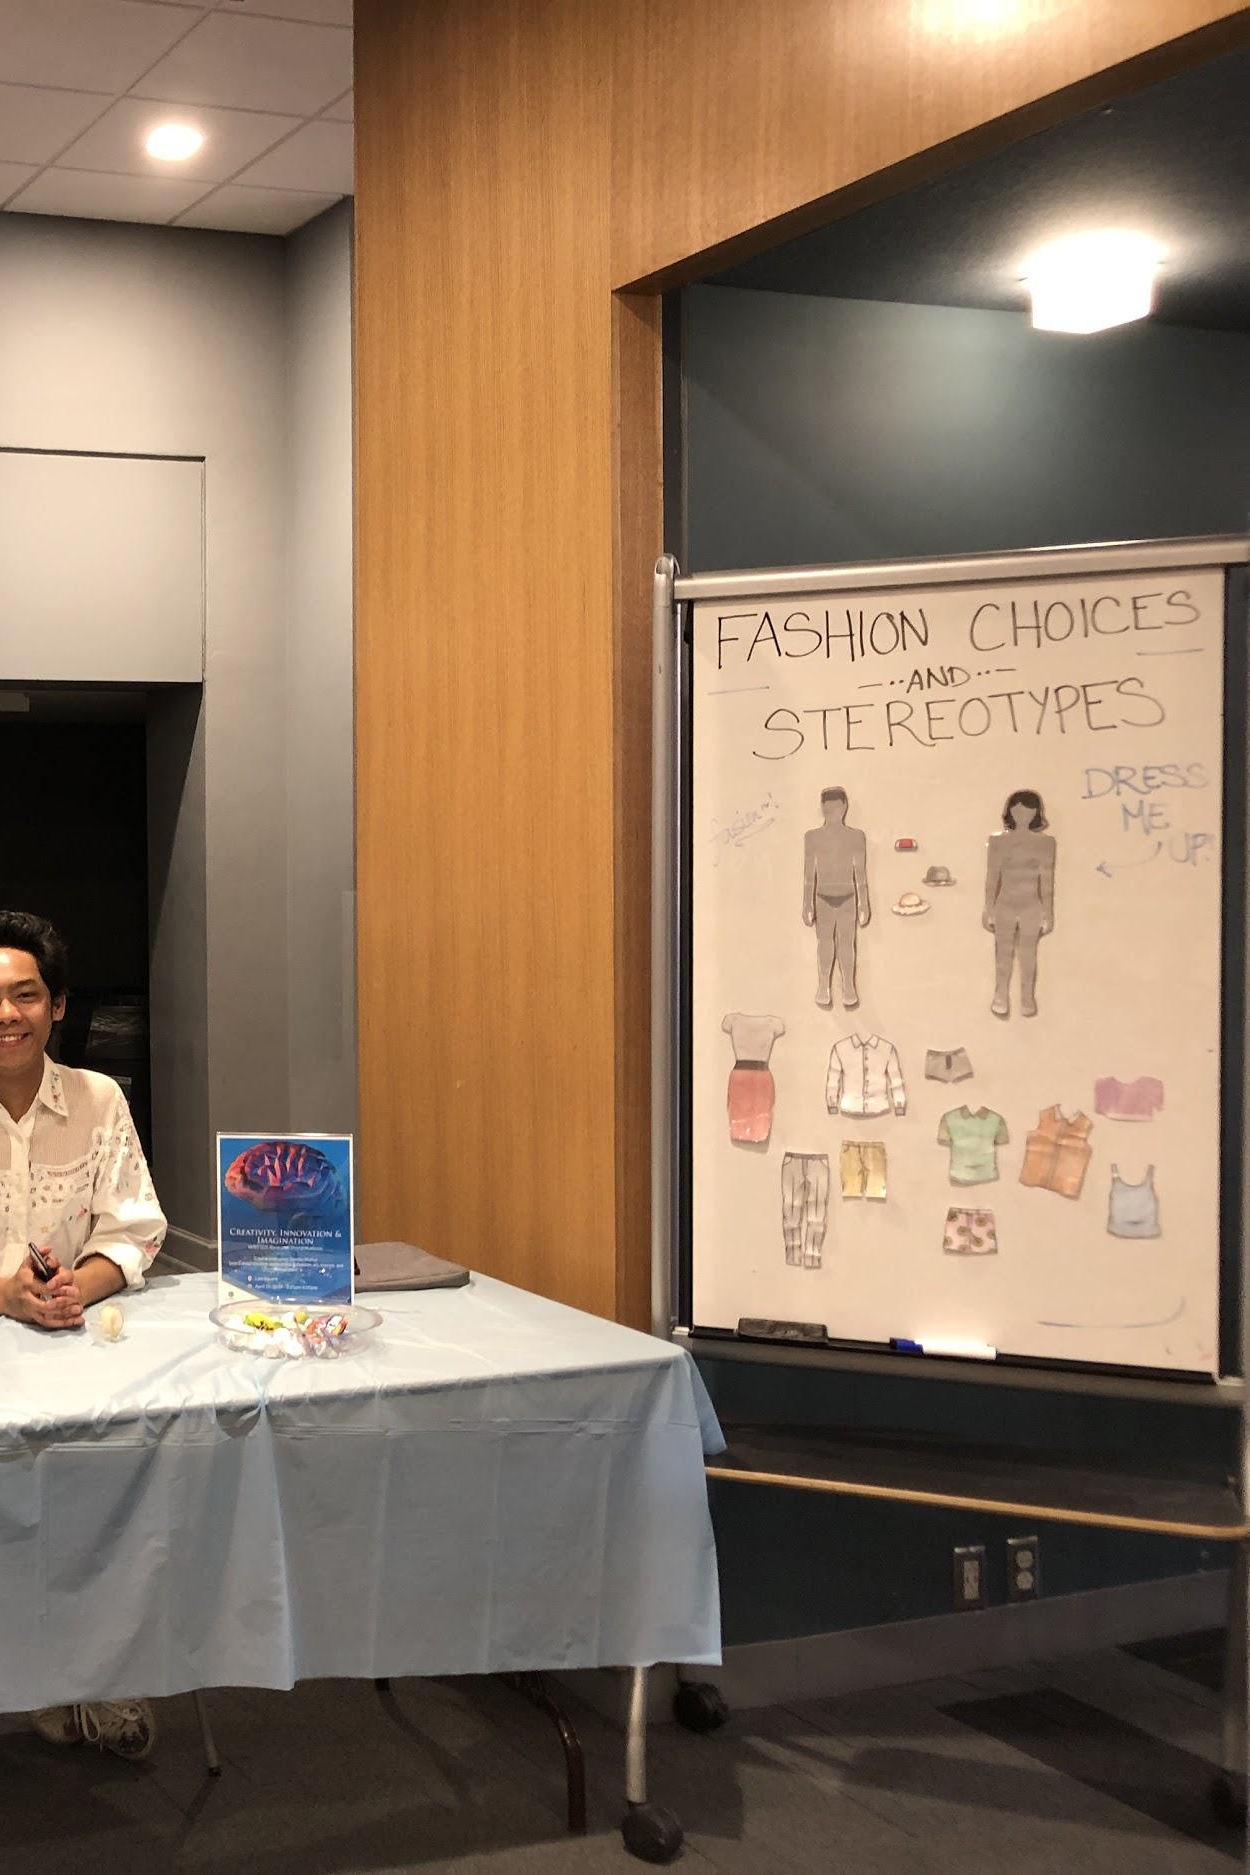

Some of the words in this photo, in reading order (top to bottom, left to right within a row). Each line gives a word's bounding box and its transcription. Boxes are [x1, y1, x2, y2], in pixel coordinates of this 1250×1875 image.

[716, 607, 929, 669] FASHION
[968, 589, 1201, 652] CHOICES
[906, 666, 970, 693] AND
[752, 677, 1166, 760] STEREOTYPES
[1081, 762, 1210, 799] DRESS
[1121, 799, 1171, 836] ME
[257, 1236, 314, 1245] IMAGINATION
[280, 1229, 333, 1238] INNOVATION
[334, 1230, 342, 1238] &
